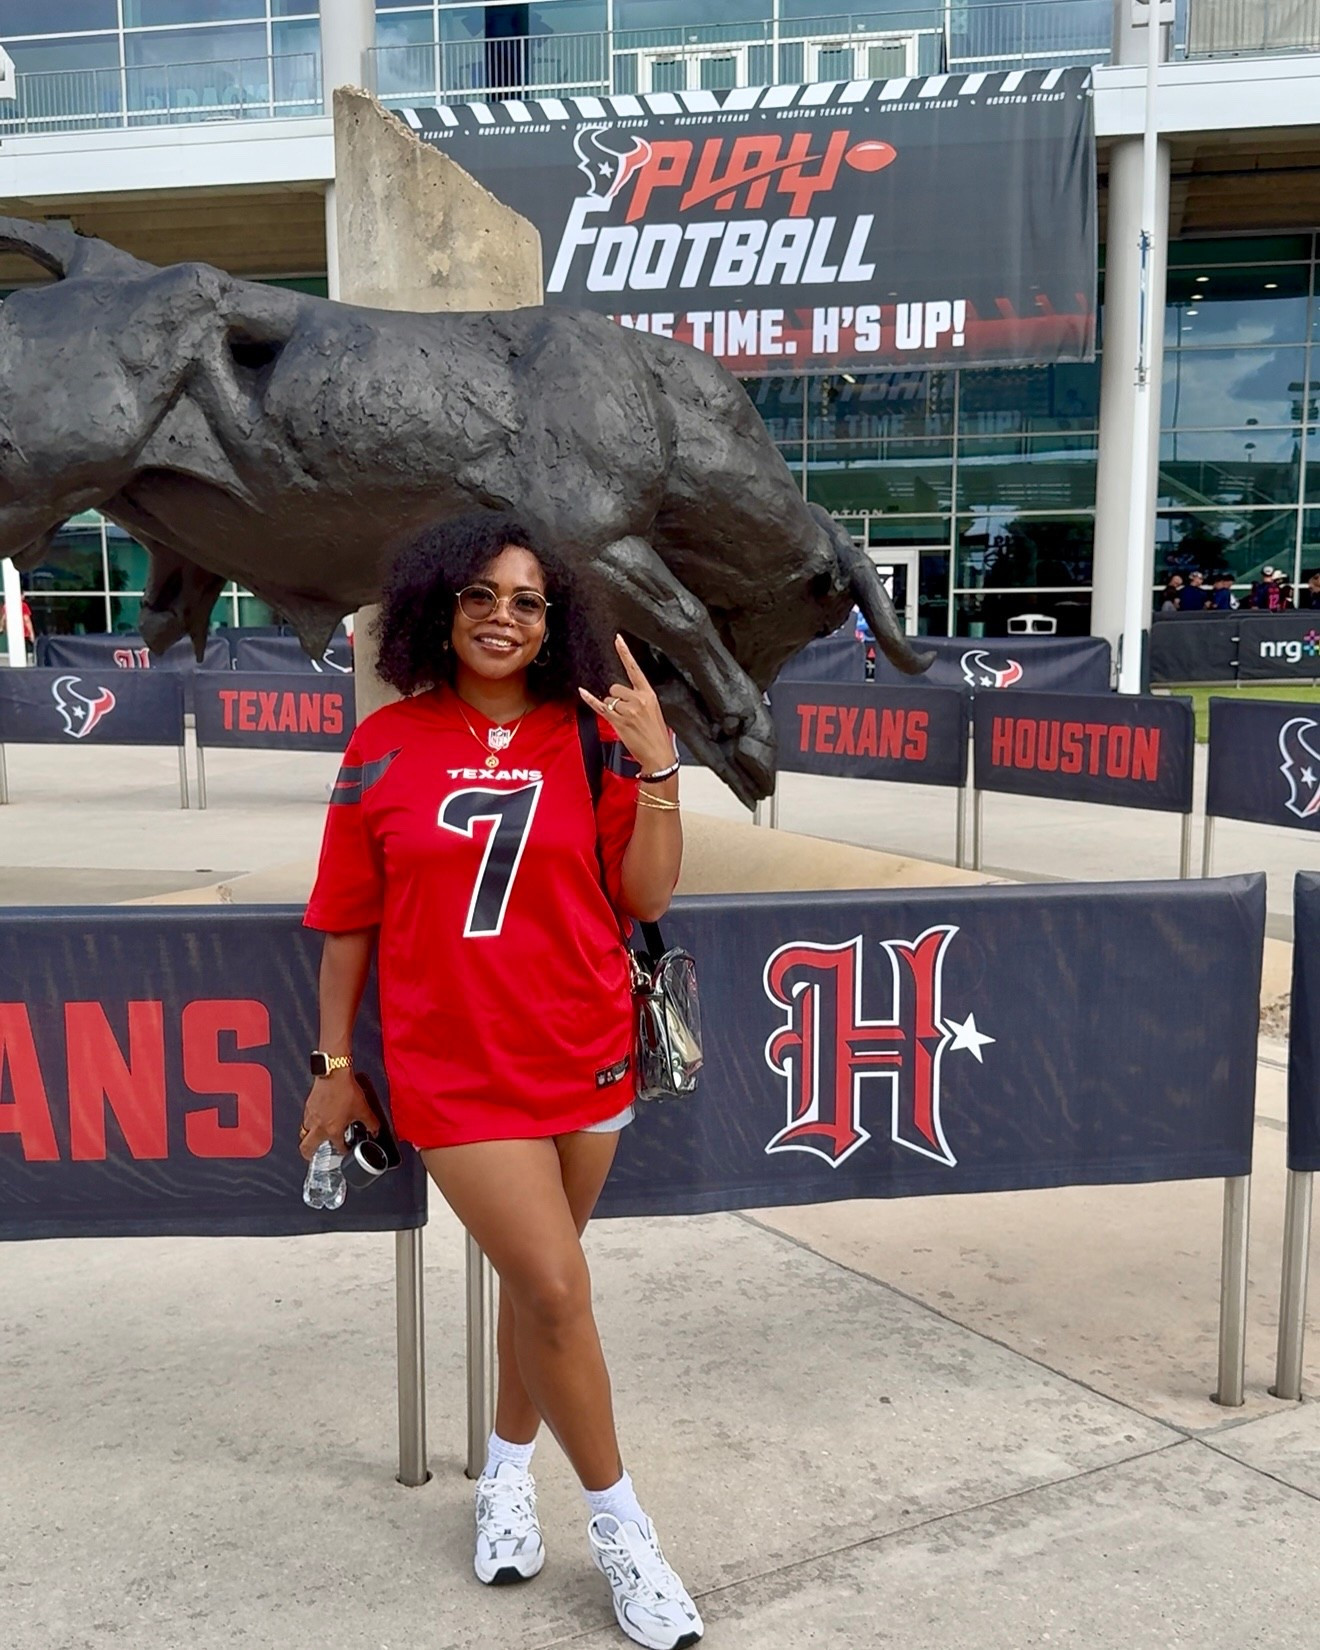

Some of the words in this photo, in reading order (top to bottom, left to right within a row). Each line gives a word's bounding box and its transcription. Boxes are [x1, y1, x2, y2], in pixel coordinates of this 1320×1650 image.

[423, 130, 454, 139] TEXANS
[479, 126, 516, 135] HOUSTON
[519, 124, 550, 133] TEXANS
[617, 119, 649, 128] TEXANS
[674, 116, 712, 126] HOUSTON
[717, 112, 750, 123] TEXANS
[776, 109, 816, 119] HOUSTON
[820, 106, 853, 116] TEXANS
[880, 102, 921, 113] HOUSTON
[925, 99, 959, 110] TEXANS
[986, 95, 1027, 106] HOUSTON
[1031, 92, 1065, 103] TEXANS
[625, 130, 850, 224] PLAY
[546, 196, 877, 293] FOOTBALL
[686, 309, 797, 357] TIME.
[812, 305, 881, 353] H'S
[895, 299, 966, 349] UP!
[1260, 641, 1302, 663] nrg
[219, 691, 344, 734] TEXANS
[797, 705, 929, 761] TEXANS
[447, 768, 543, 780] TEXANS
[991, 717, 1161, 782] HOUSTON
[438, 780, 544, 938] 7
[763, 924, 960, 1168] H
